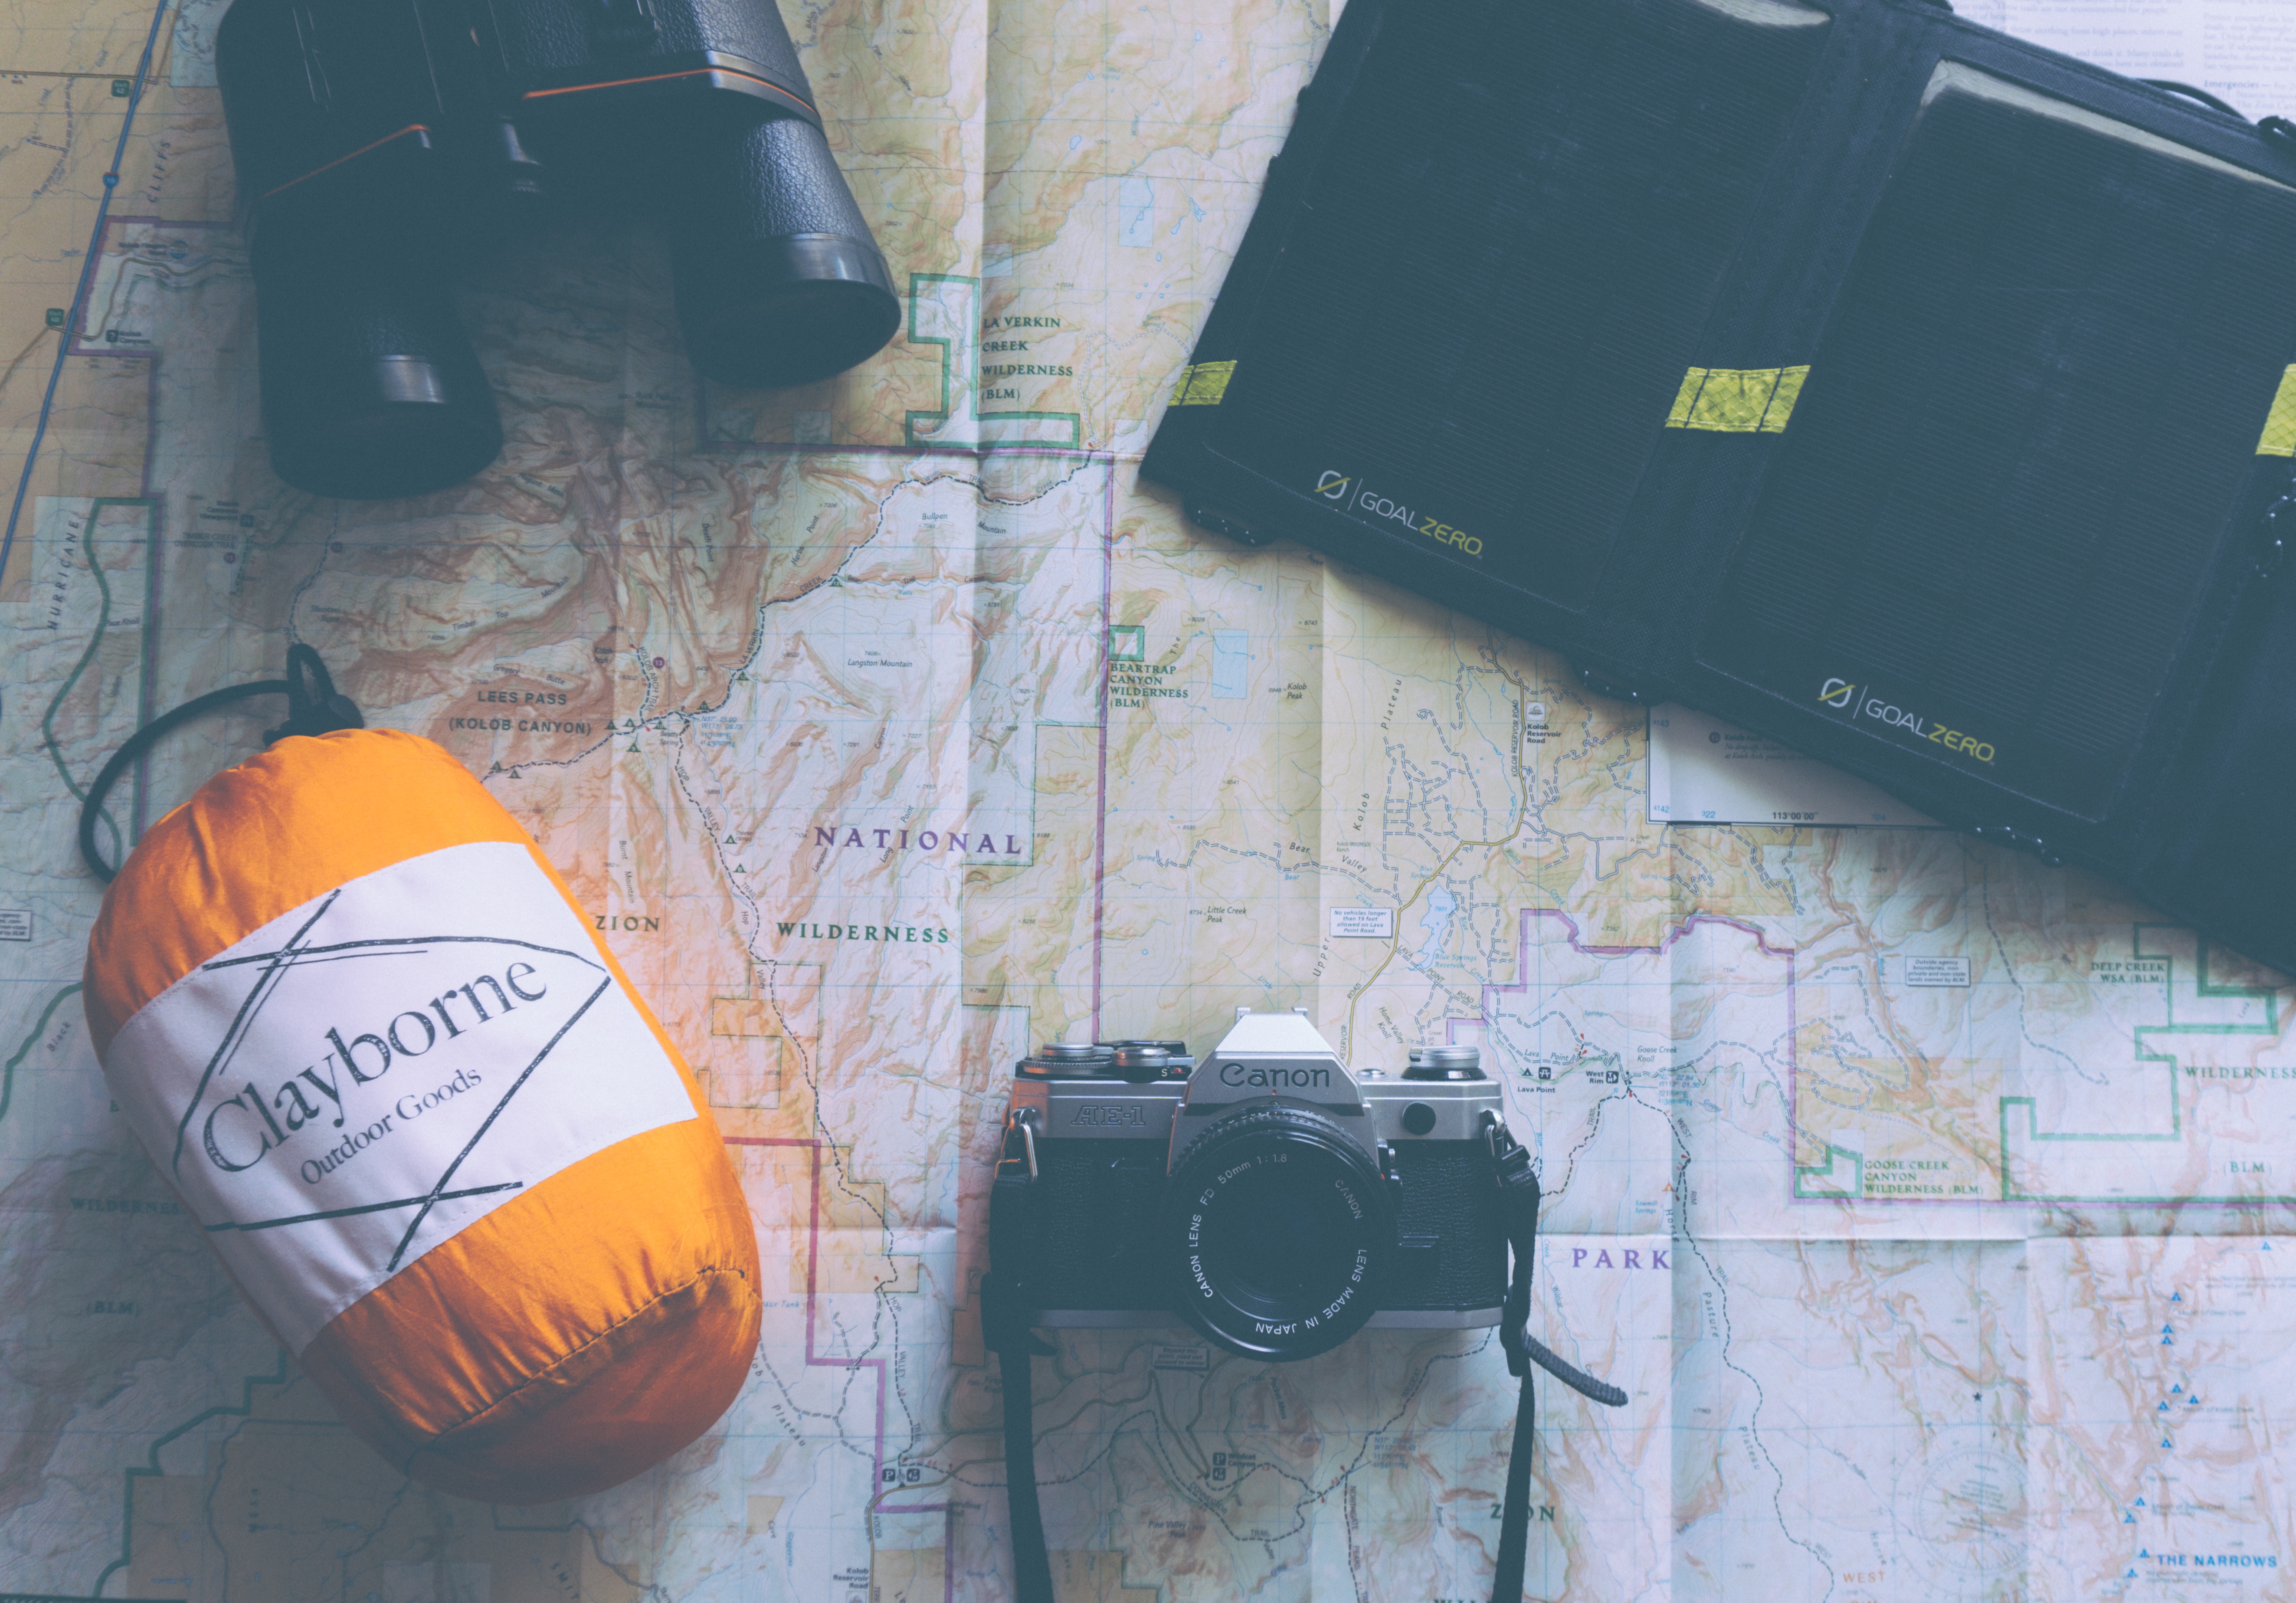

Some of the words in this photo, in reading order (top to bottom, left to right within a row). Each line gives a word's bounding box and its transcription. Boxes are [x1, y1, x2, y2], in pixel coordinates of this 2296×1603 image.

[147, 141, 171, 203] CLIFFS
[983, 317, 1000, 328] LA
[1005, 317, 1061, 328] VERKIN
[982, 341, 1029, 352] CREEK
[982, 365, 1073, 377] WILDERNESS
[981, 389, 1021, 401] (BLM)
[806, 515, 819, 534] Point
[922, 512, 947, 521] Bullpen
[702, 523, 711, 542] Death
[704, 544, 714, 563] Point
[47, 520, 80, 631] HURRICANE
[800, 576, 822, 593] CREEK
[452, 619, 476, 631] Timber
[541, 576, 569, 598] Mountain
[493, 664, 520, 675] Gregory
[546, 673, 565, 685] Butte
[638, 646, 652, 671] KOLOB
[650, 673, 658, 694] ARCH
[1111, 663, 1177, 675] BEARTRAP
[1110, 675, 1163, 685] CANYON
[477, 691, 518, 704] LEES
[524, 692, 567, 705] PASS
[1110, 686, 1188, 698] WILDERNESS
[1110, 697, 1145, 709] (BLM)
[449, 718, 511, 731] (KOLOB
[517, 719, 592, 736] CANYON)
[1353, 792, 1370, 831] Kolob
[1381, 679, 1402, 730] Plateau
[677, 766, 690, 781] HOP
[703, 806, 721, 832] VALLEY
[813, 826, 1023, 854] NATIONAL
[1289, 842, 1310, 853] Bear
[619, 840, 628, 860] Burnt
[624, 871, 635, 904] Mountain
[1342, 855, 1367, 873] Valley
[740, 882, 757, 899] TRAIL
[596, 915, 660, 932] ZION
[1207, 915, 1223, 923] Peak
[776, 922, 949, 944] WILDERNESS
[1312, 938, 1330, 977] Upper
[1398, 944, 1413, 959] LAVA
[1427, 967, 1445, 983] POINT
[1456, 990, 1474, 1003] ROAD
[1470, 968, 1487, 983] Creek
[2091, 962, 2121, 972] DEEP
[2126, 964, 2165, 972] CREEK
[756, 969, 766, 990] Valley
[2101, 974, 2126, 983] WSA
[2130, 975, 2165, 984] (BLM)
[1346, 983, 1362, 1000] ROAD
[1377, 1022, 1392, 1039] Knoll
[1378, 1006, 1392, 1024] Home
[1390, 1024, 1404, 1044] Valley
[47, 1022, 71, 1052] Black
[1524, 1049, 1539, 1058] Lava
[1550, 1052, 1569, 1062] Point
[202, 962, 547, 1174] Clayborne
[1219, 1063, 1330, 1088] Canon
[1070, 1106, 1146, 1126] AE-1
[1587, 1107, 1596, 1126] TRAIL
[300, 1117, 395, 1185] Outdoor
[395, 1067, 482, 1119] Goods
[1218, 1162, 1251, 1184] 50mm
[1865, 1160, 1904, 1170] GOOSE
[1909, 1160, 1949, 1170] CREEK
[2224, 1161, 2273, 1176] (BLM)
[1865, 1172, 1917, 1182] CANYON
[1200, 1189, 1214, 1205] FD
[1865, 1184, 1944, 1194] WILDERNESS
[1949, 1184, 1983, 1196] (BLM)
[71, 1197, 184, 1214] WILDERNES
[1336, 1180, 1363, 1219] CANON
[1189, 1214, 1202, 1247] LENS
[1352, 1249, 1367, 1282] LENS
[1572, 1248, 1672, 1269] PARK
[1190, 1256, 1213, 1297] CANON
[1716, 1266, 1729, 1285] TRAIL
[891, 1297, 901, 1312] HOP
[1323, 1287, 1353, 1318] MADE
[1305, 1317, 1319, 1328] IN
[1703, 1292, 1718, 1338] Pasture
[1256, 1323, 1297, 1334] JAPAN
[898, 1351, 906, 1378] VALLEY
[913, 1423, 921, 1444] TRAIL
[772, 1404, 806, 1447] Plateau
[1738, 1426, 1760, 1470] Plateau
[1490, 1504, 1556, 1521] ZN
[2158, 1555, 2187, 1566] THE
[2194, 1555, 2277, 1568] NARROWS
[1843, 1571, 1886, 1584] WEST
